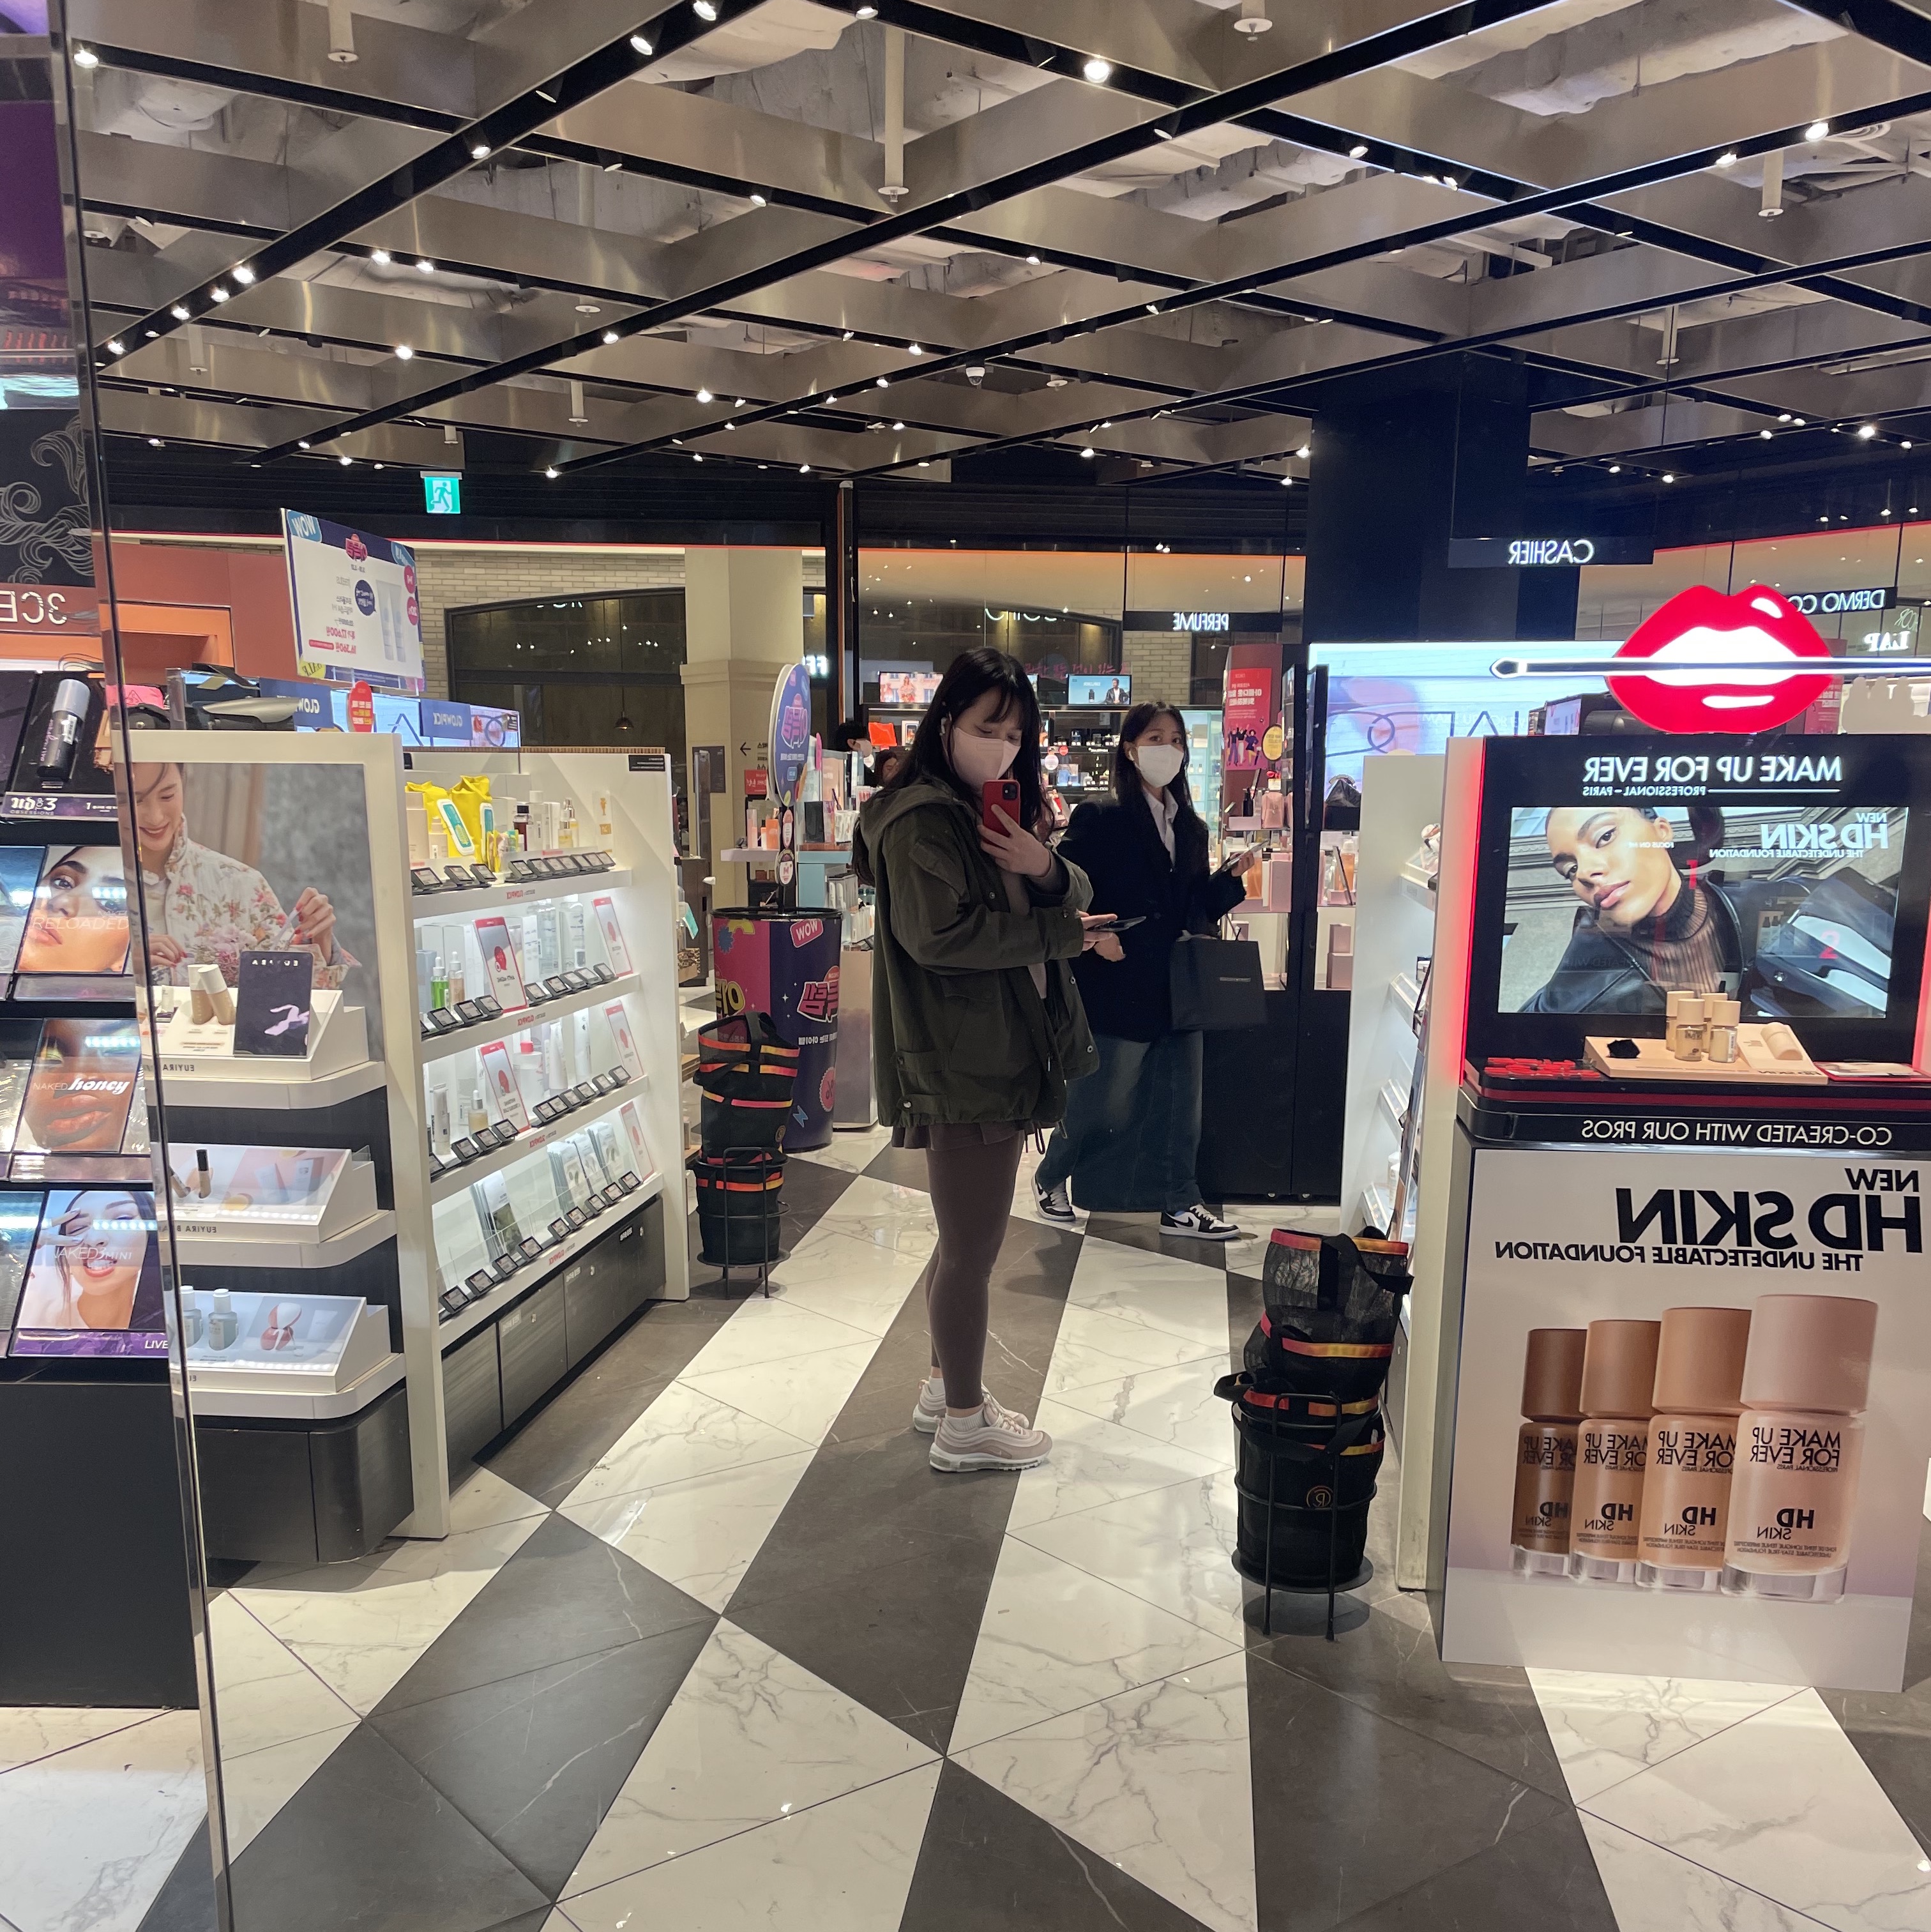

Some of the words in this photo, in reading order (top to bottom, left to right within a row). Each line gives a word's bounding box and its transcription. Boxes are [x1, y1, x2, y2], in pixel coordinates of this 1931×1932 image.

[43, 798, 58, 811] 3
[33, 917, 128, 930] RELOADED
[68, 1078, 130, 1095] honey
[105, 1252, 132, 1260] MINI
